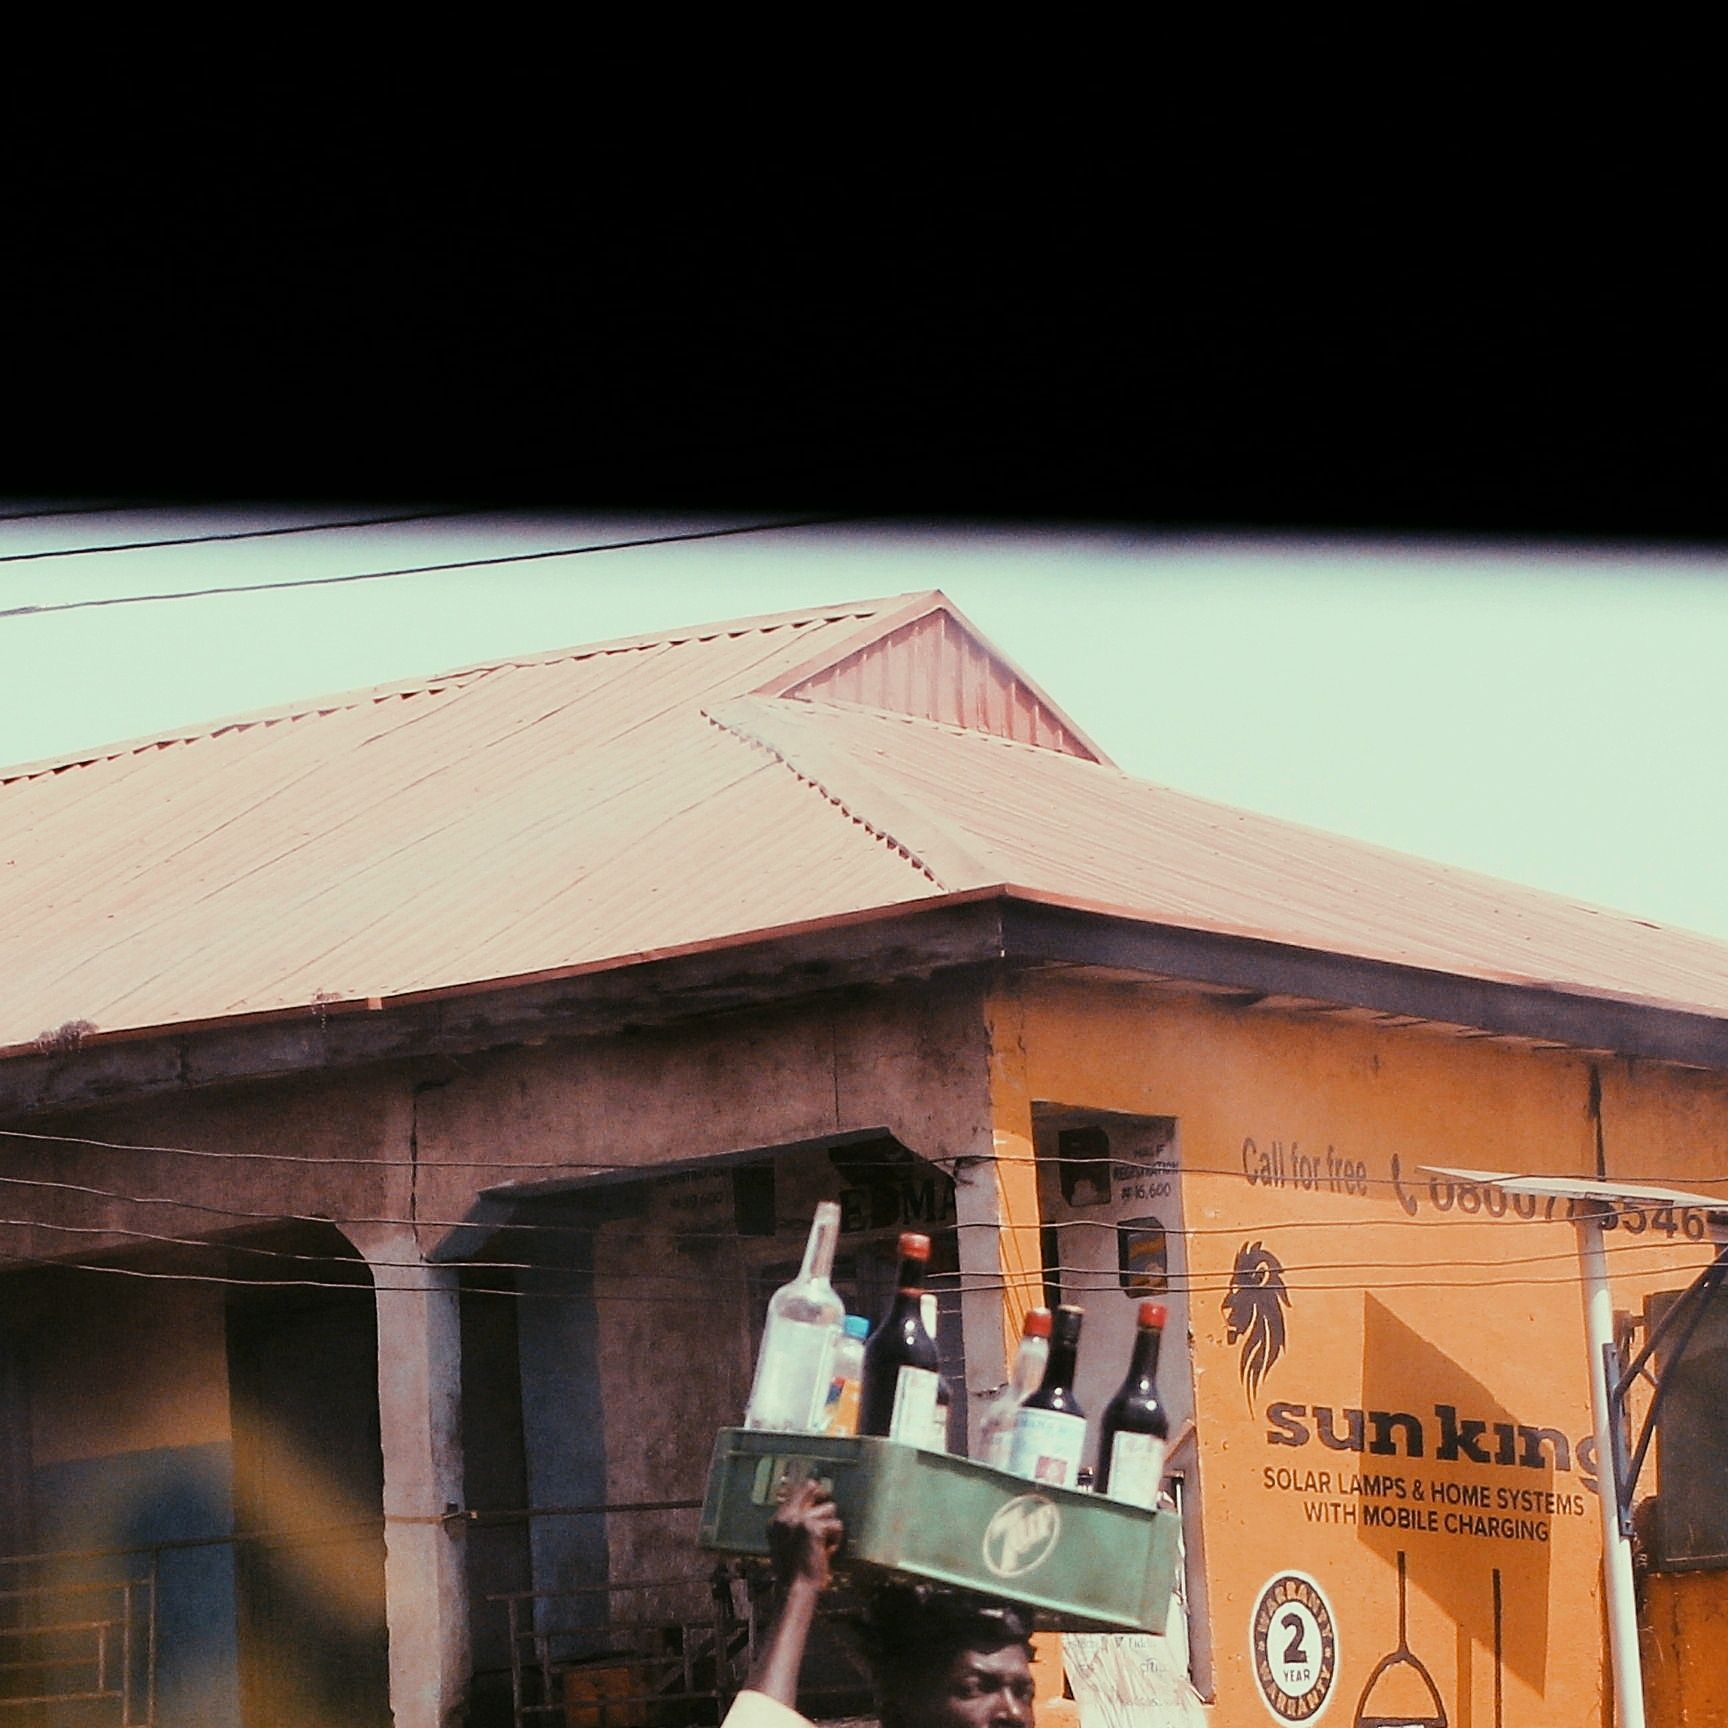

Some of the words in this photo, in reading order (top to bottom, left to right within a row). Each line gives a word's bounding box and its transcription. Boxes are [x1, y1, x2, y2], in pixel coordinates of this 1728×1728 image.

[1242, 1137, 1285, 1187] Call
[1290, 1144, 1321, 1192] for
[1327, 1146, 1367, 1197] free
[1266, 1401, 1425, 1458] sun
[1263, 1467, 1331, 1495] SOLAR
[1338, 1473, 1407, 1500] LAMPS
[1412, 1479, 1425, 1500] &
[1431, 1481, 1490, 1509] HOME
[1497, 1487, 1584, 1517] SYSTEMS
[1304, 1501, 1356, 1526] WITH
[1363, 1505, 1439, 1533] MOBILE
[1444, 1513, 1549, 1542] CHARGING
[1281, 1613, 1308, 1664] 2
[1284, 1668, 1311, 1683] YEAR
